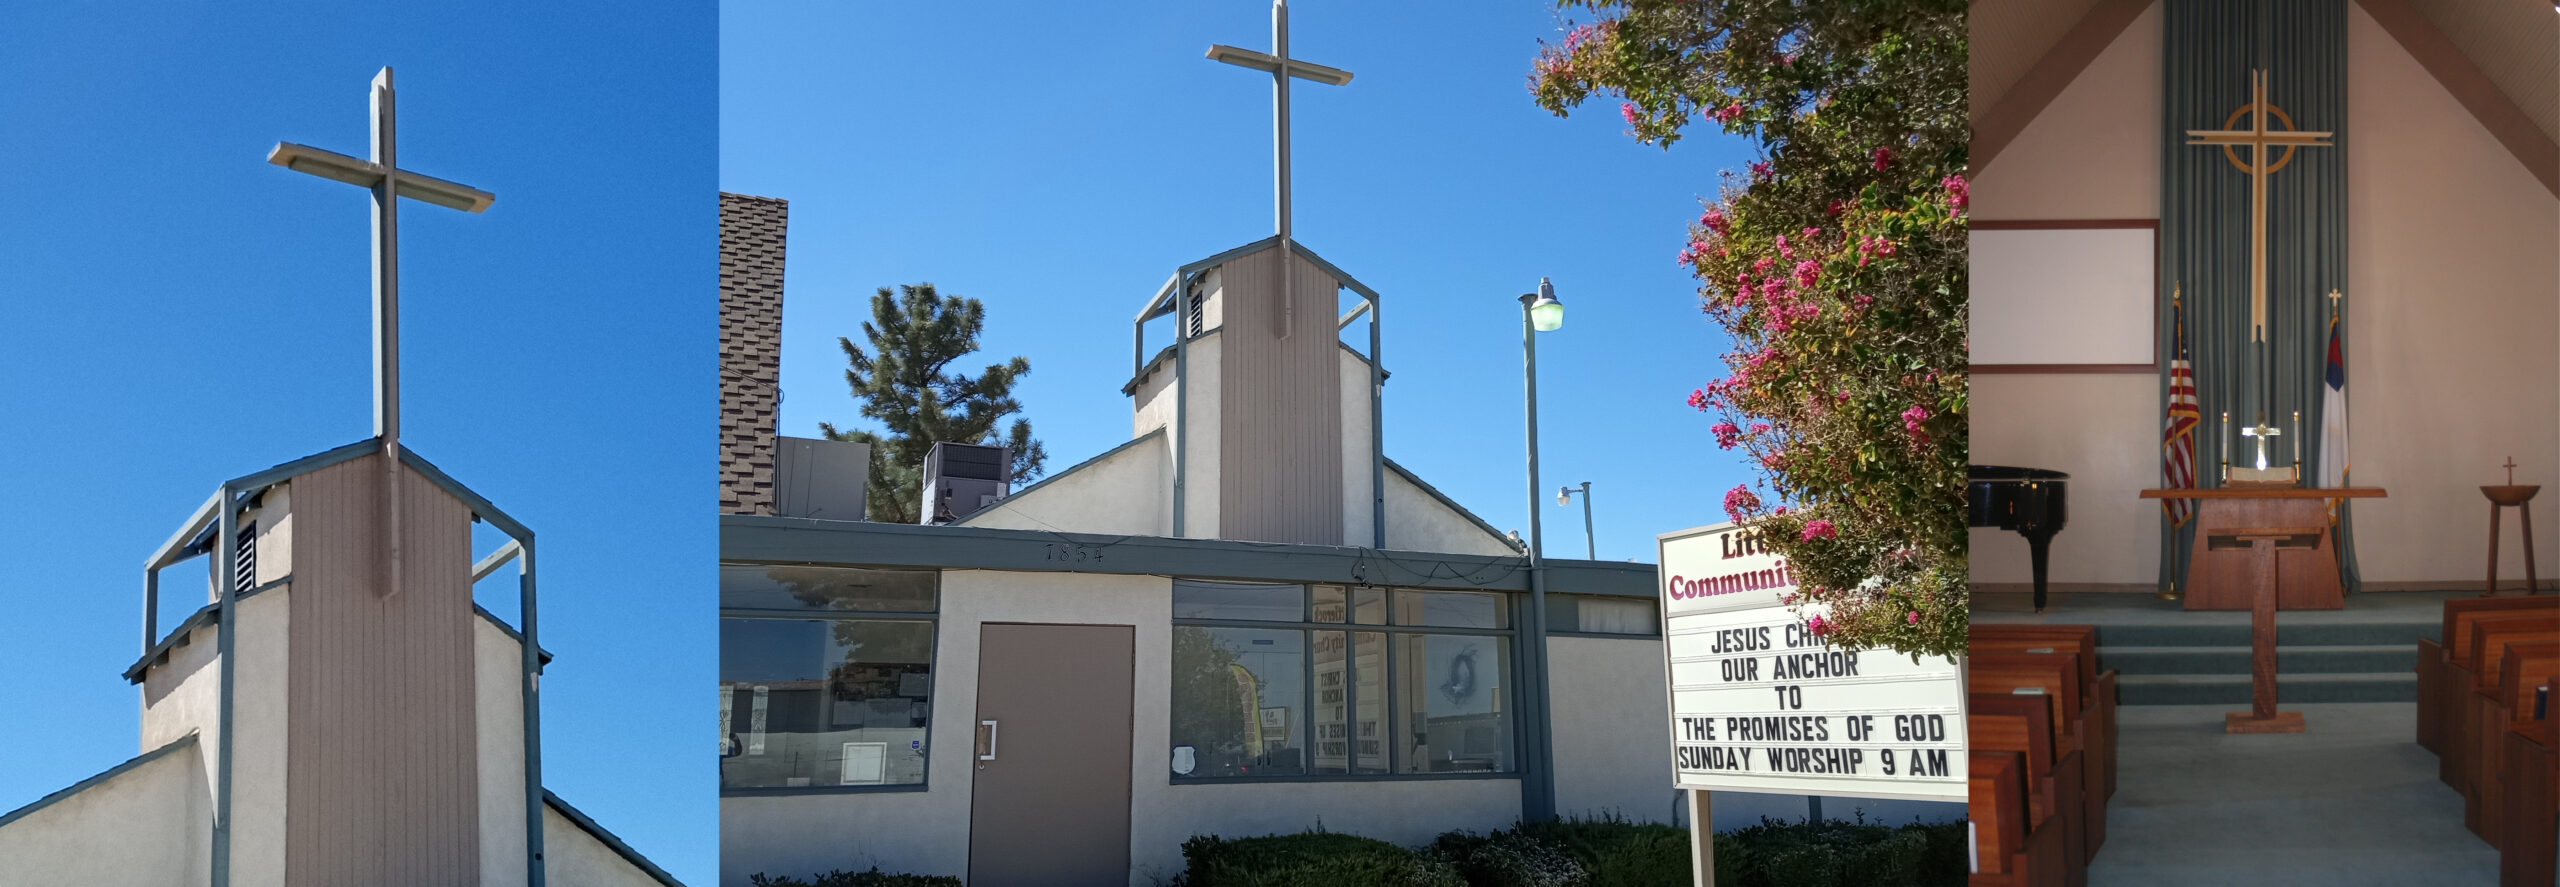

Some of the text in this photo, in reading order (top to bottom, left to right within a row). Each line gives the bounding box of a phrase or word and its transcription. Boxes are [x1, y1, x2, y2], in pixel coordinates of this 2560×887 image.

[1711, 626, 1771, 654] JESUS
[1721, 650, 1859, 682] OUR ANCHOR
[1774, 685, 1802, 710] TO
[1682, 713, 1945, 742] THE PROMISES OF GOD
[1679, 746, 1949, 777] SUNDAY WORSHIP 9 AM
